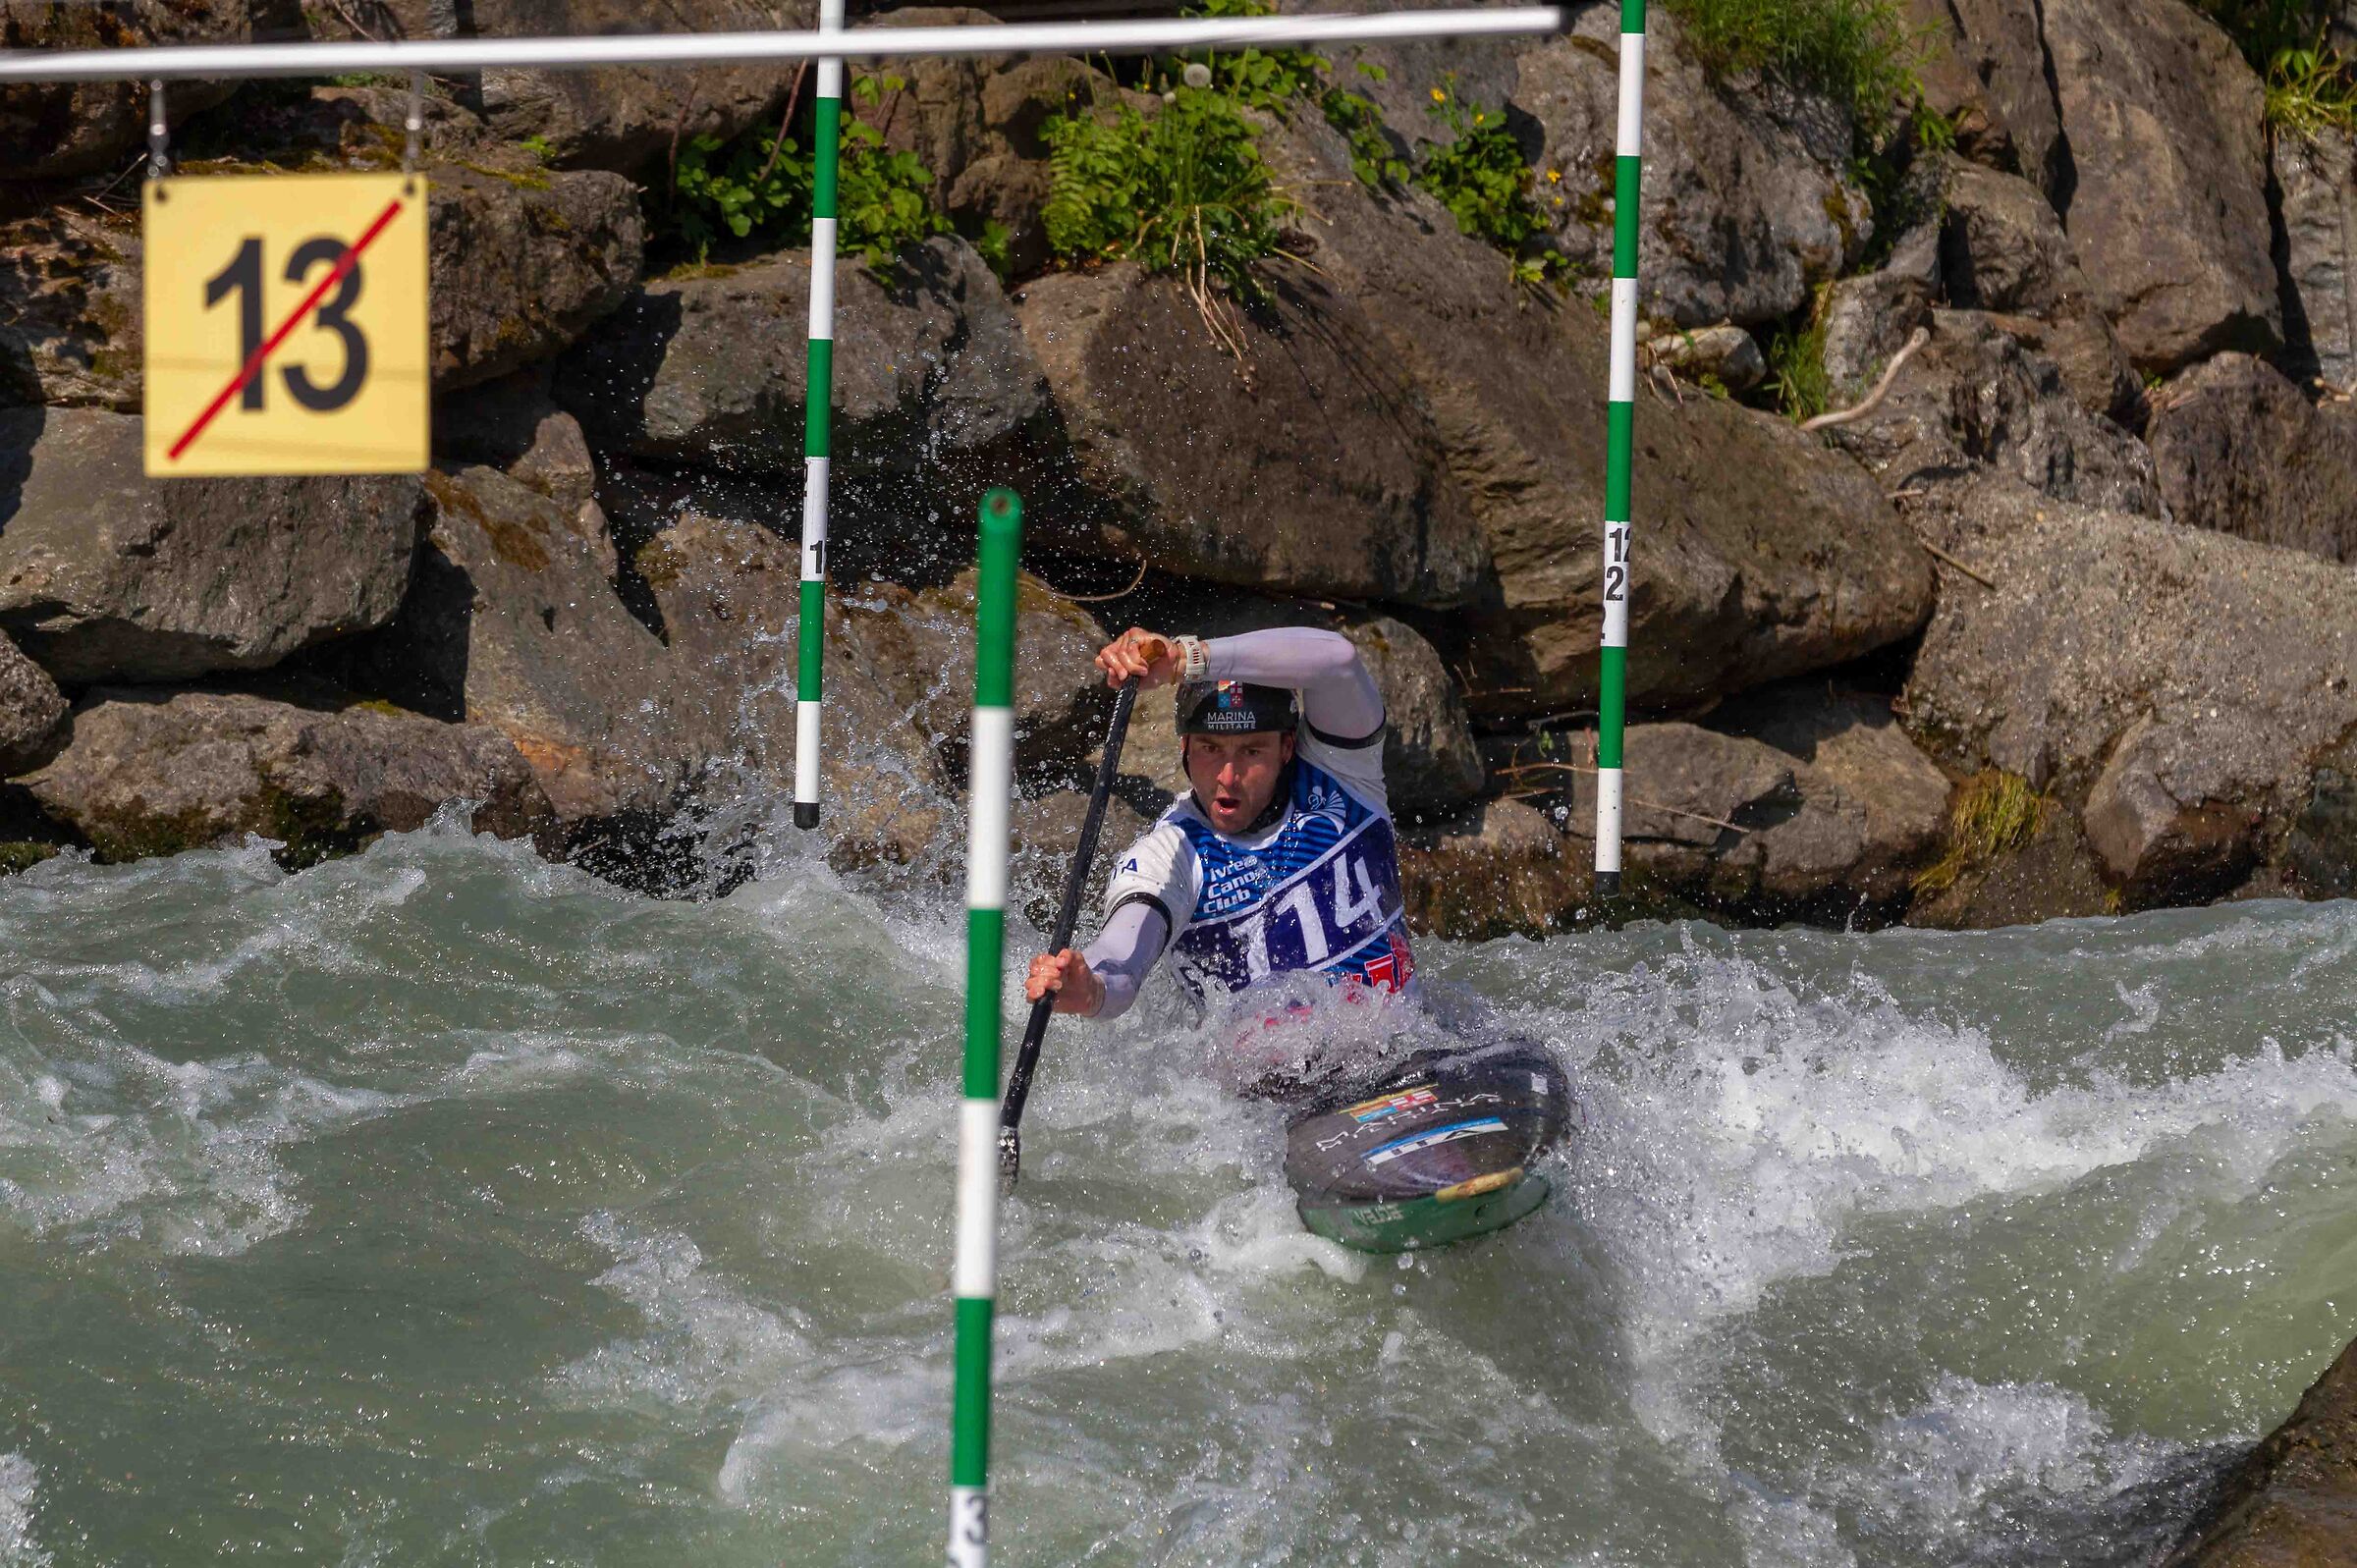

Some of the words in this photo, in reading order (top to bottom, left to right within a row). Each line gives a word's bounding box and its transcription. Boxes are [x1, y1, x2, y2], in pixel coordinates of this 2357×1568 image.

[204, 236, 370, 413] 13
[809, 540, 823, 574] 1
[1606, 566, 1623, 601] 2
[1207, 711, 1256, 722] MARINA
[965, 1493, 990, 1547] 3
